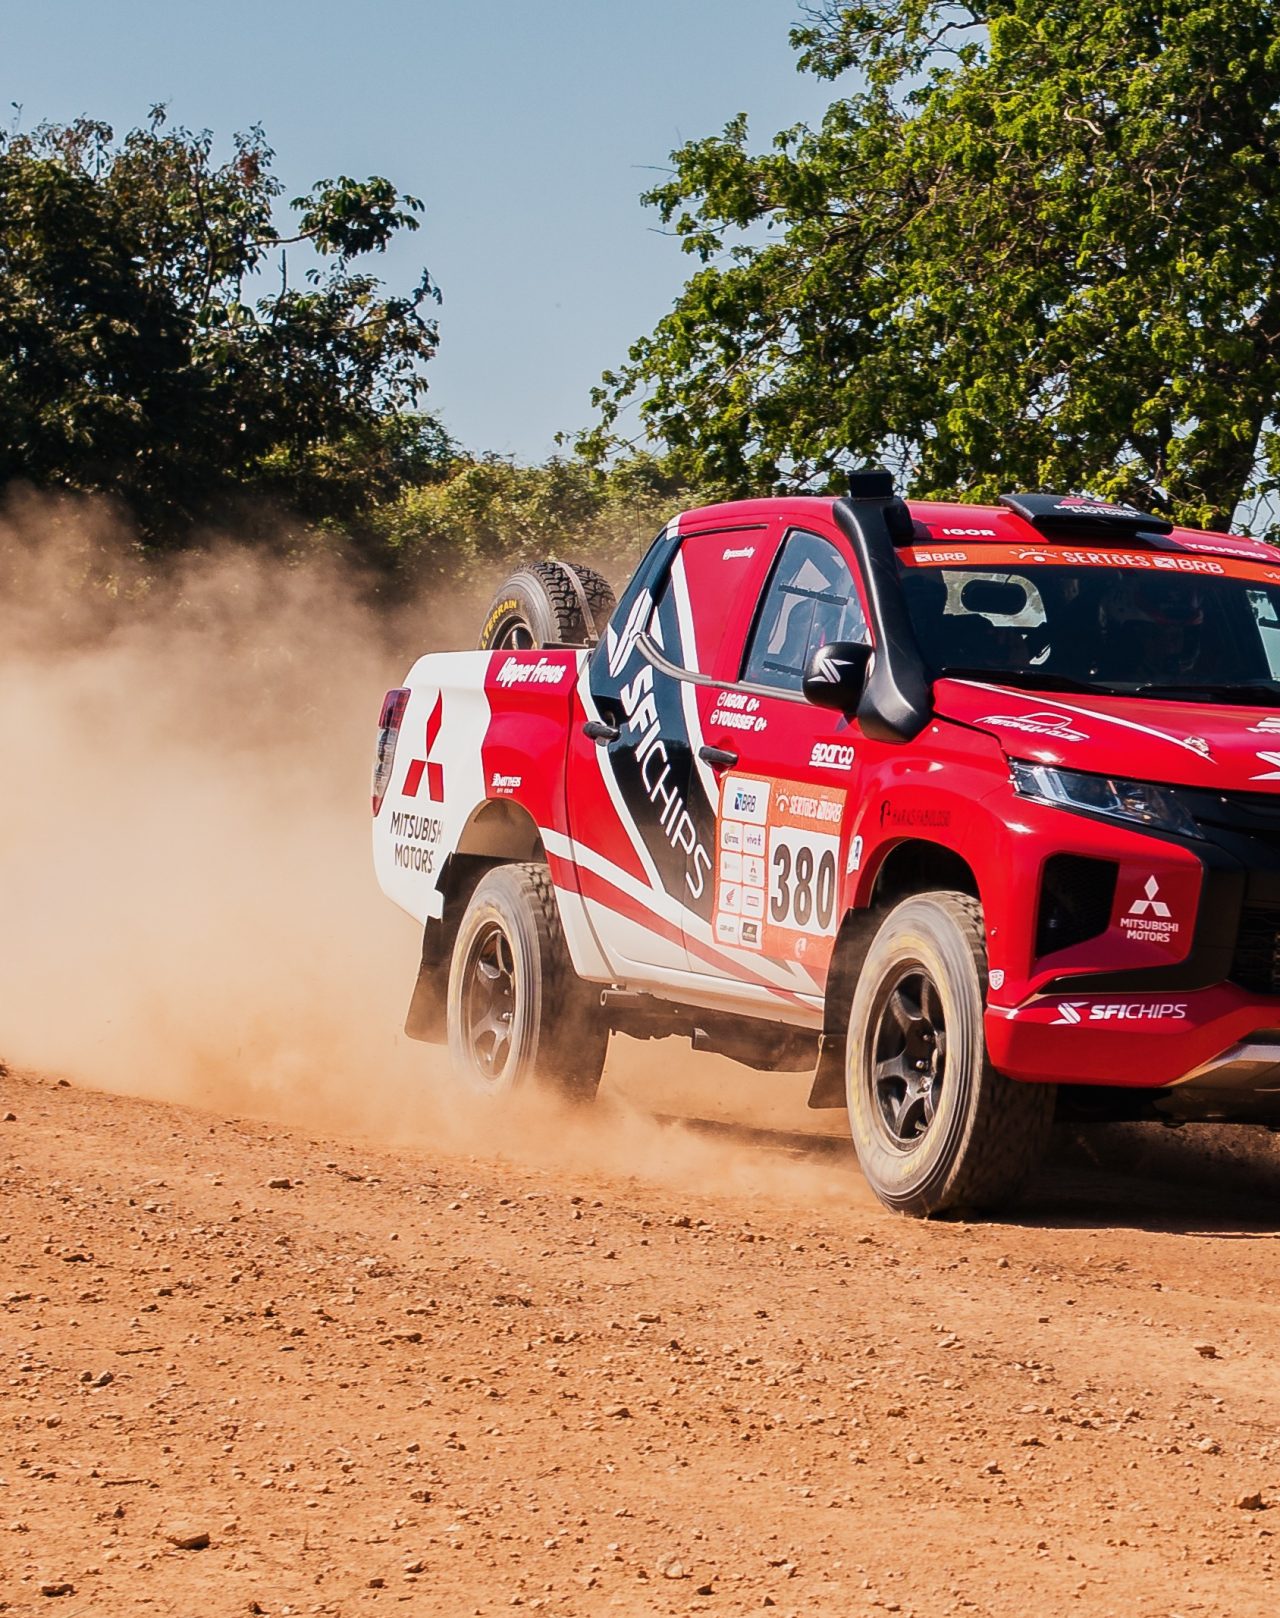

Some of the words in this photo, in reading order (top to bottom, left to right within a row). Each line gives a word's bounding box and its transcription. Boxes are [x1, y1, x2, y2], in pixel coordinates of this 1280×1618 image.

[942, 528, 997, 537] IGOR
[931, 552, 968, 562] BRB
[1177, 559, 1225, 574] BRB
[483, 599, 517, 639] TERRAIN
[723, 693, 748, 710] IGOR
[716, 711, 756, 731] YOUSSEF
[810, 742, 855, 766] sparco
[619, 664, 712, 900] SFICHIPS
[741, 793, 757, 813] BRB
[390, 811, 444, 844] MITSUBISH
[394, 842, 434, 874] MOTORS
[770, 843, 836, 930] 380
[1120, 917, 1179, 932] MITSUBISHI
[1126, 929, 1170, 942] MOTORS
[1089, 1003, 1188, 1020] SFICHIPS
